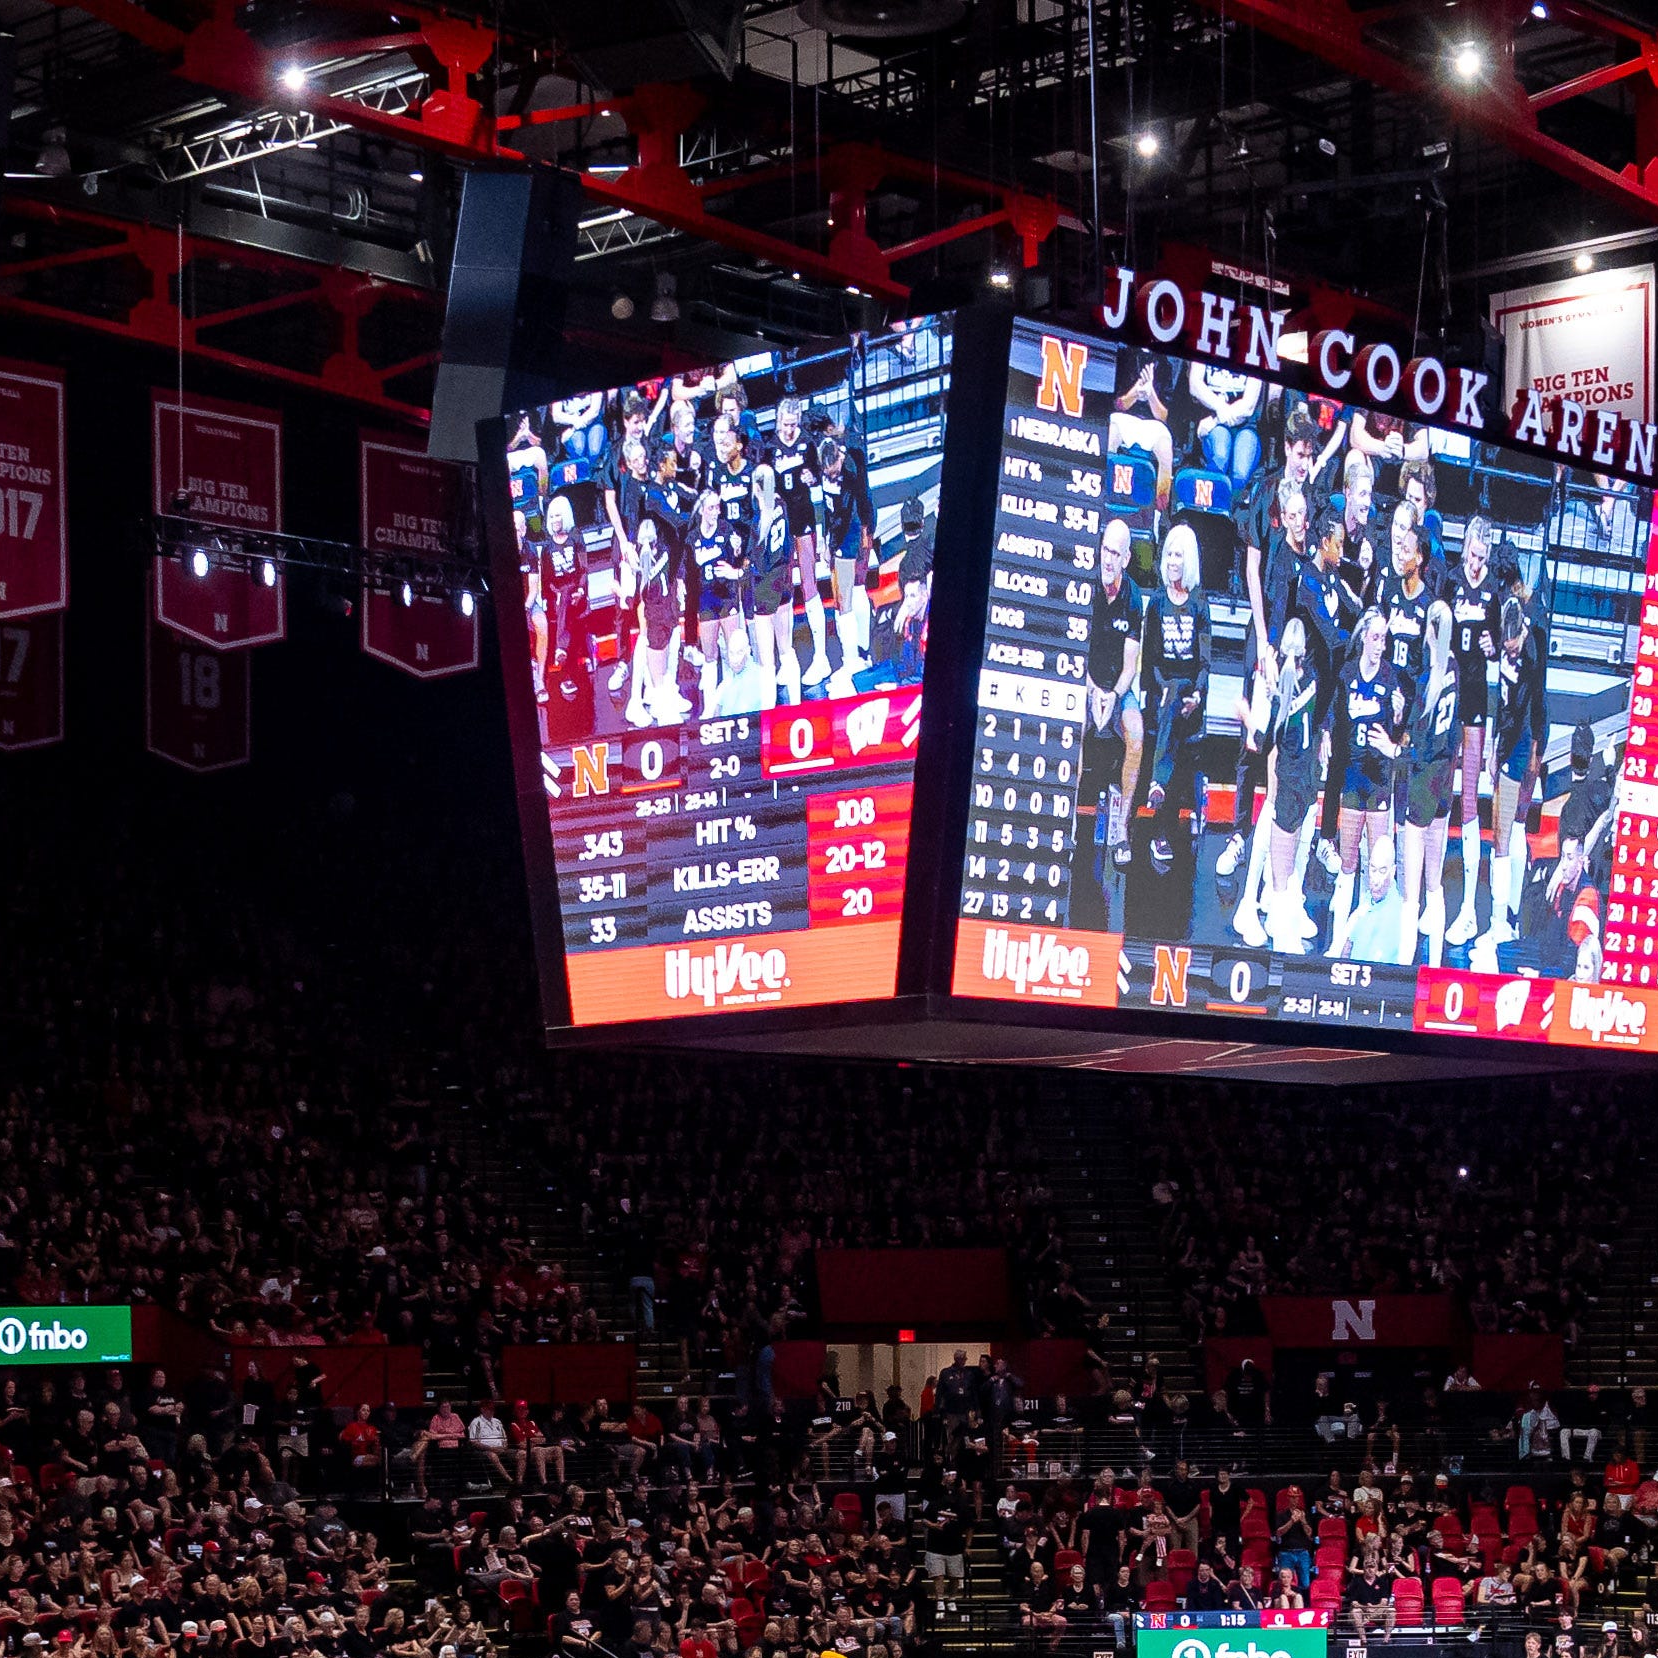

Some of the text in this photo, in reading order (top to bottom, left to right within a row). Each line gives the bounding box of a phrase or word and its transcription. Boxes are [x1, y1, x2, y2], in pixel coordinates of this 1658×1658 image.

[1103, 267, 1286, 372] JOHN
[1319, 328, 1491, 430] COOK
[1037, 334, 1088, 418] N
[1533, 366, 1610, 393] BIG TEN
[1018, 415, 1101, 456] NEBRASKA
[188, 476, 218, 497] BIG
[1066, 469, 1102, 497] .343
[188, 497, 269, 522] AMPIONS
[1073, 544, 1095, 570] 33
[994, 568, 1049, 598] BLOCKS
[991, 604, 1088, 642] DIGS 35
[180, 651, 222, 710] 18
[1056, 652, 1084, 680] 0-3
[983, 714, 1074, 750] 2 1 1 5
[573, 718, 814, 797] N 0 SET 3 0
[709, 755, 741, 780] 2-0
[980, 748, 1071, 783] 3 4 0 0
[974, 783, 1070, 818] 10 0 0 10
[578, 797, 876, 861] .343 HIT % .108
[974, 820, 1064, 852] 11 5 3 5
[578, 842, 886, 902] 35-11 KILLS-ERR 20-12
[968, 855, 1061, 887] 14 2 4 0
[590, 888, 873, 943] 33 ASSISTS 20
[962, 891, 1058, 922] 27 2 4
[1150, 945, 1463, 1022] N 0 SET 3 0
[29, 1321, 87, 1350] fnbo
[1331, 1300, 1377, 1340] N
